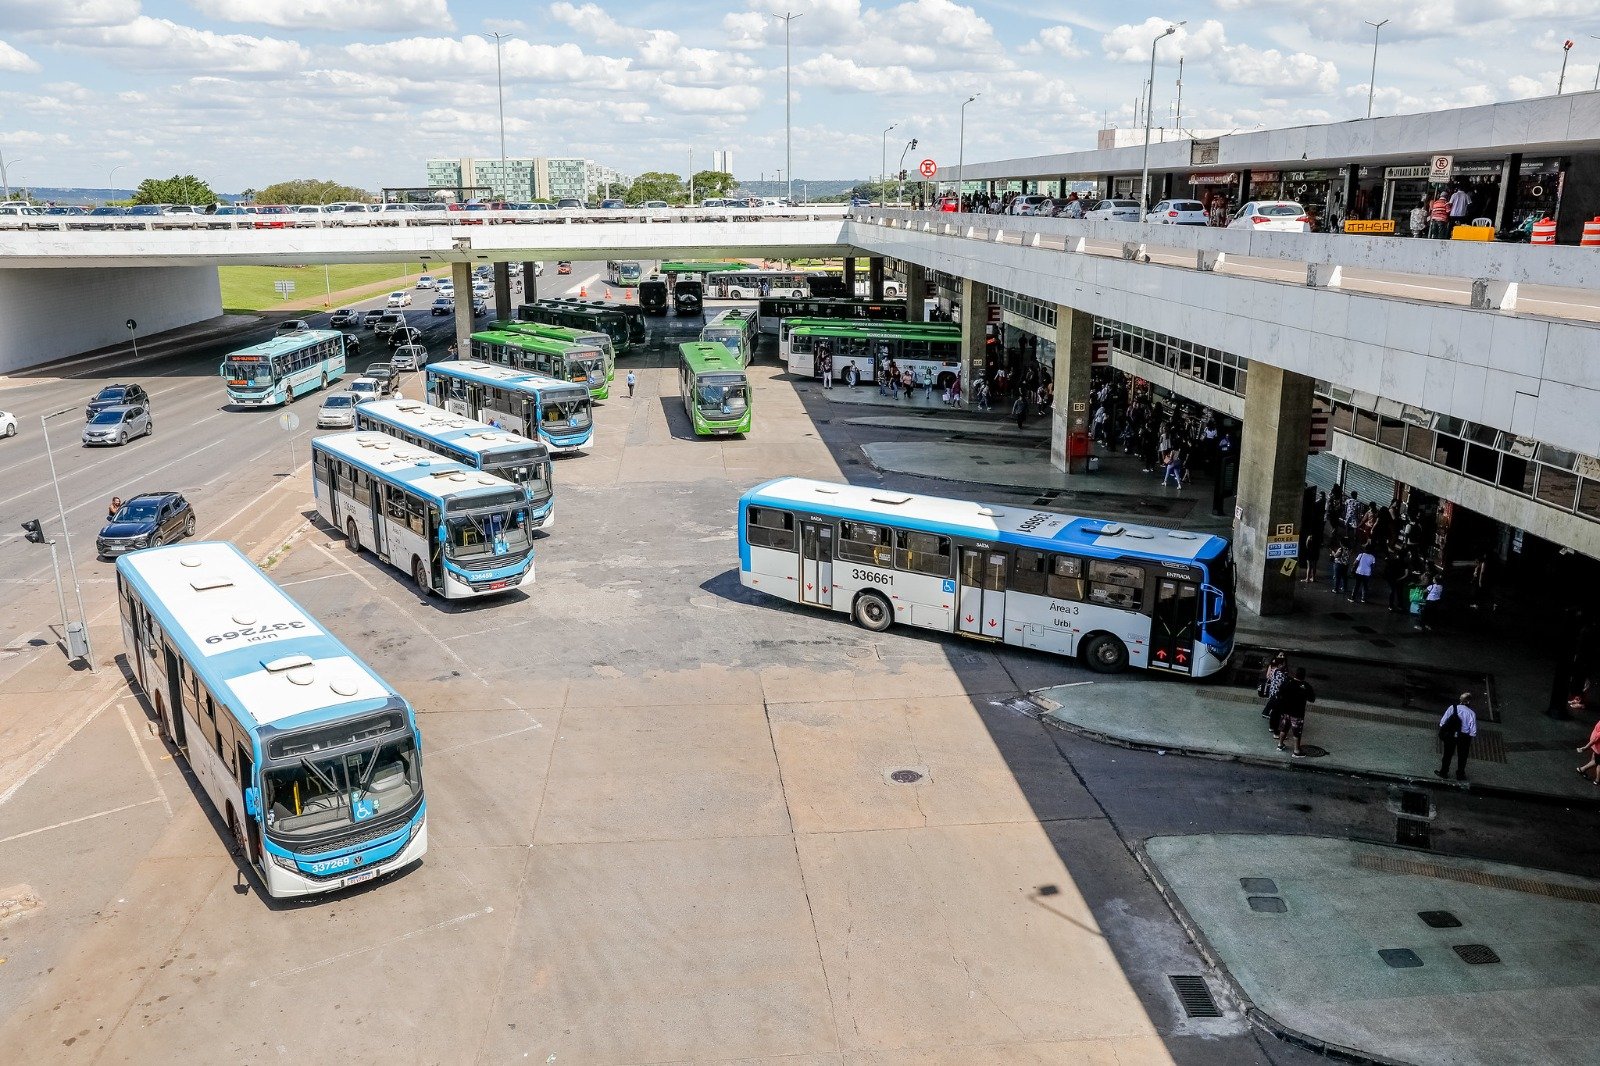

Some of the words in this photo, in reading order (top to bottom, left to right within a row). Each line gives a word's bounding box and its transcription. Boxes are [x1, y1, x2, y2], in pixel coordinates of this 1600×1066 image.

[988, 306, 1000, 322] E
[1092, 343, 1108, 362] E
[1309, 417, 1328, 447] E
[1278, 525, 1292, 534] E6
[852, 568, 894, 586] 336661
[1166, 572, 1191, 580] ENTRADA
[1049, 600, 1071, 614] Área
[1073, 606, 1080, 615] 3
[1054, 618, 1071, 628] Urbi
[206, 621, 306, 644] 337269
[247, 633, 278, 642] Urbi
[312, 857, 350, 873] 337269
